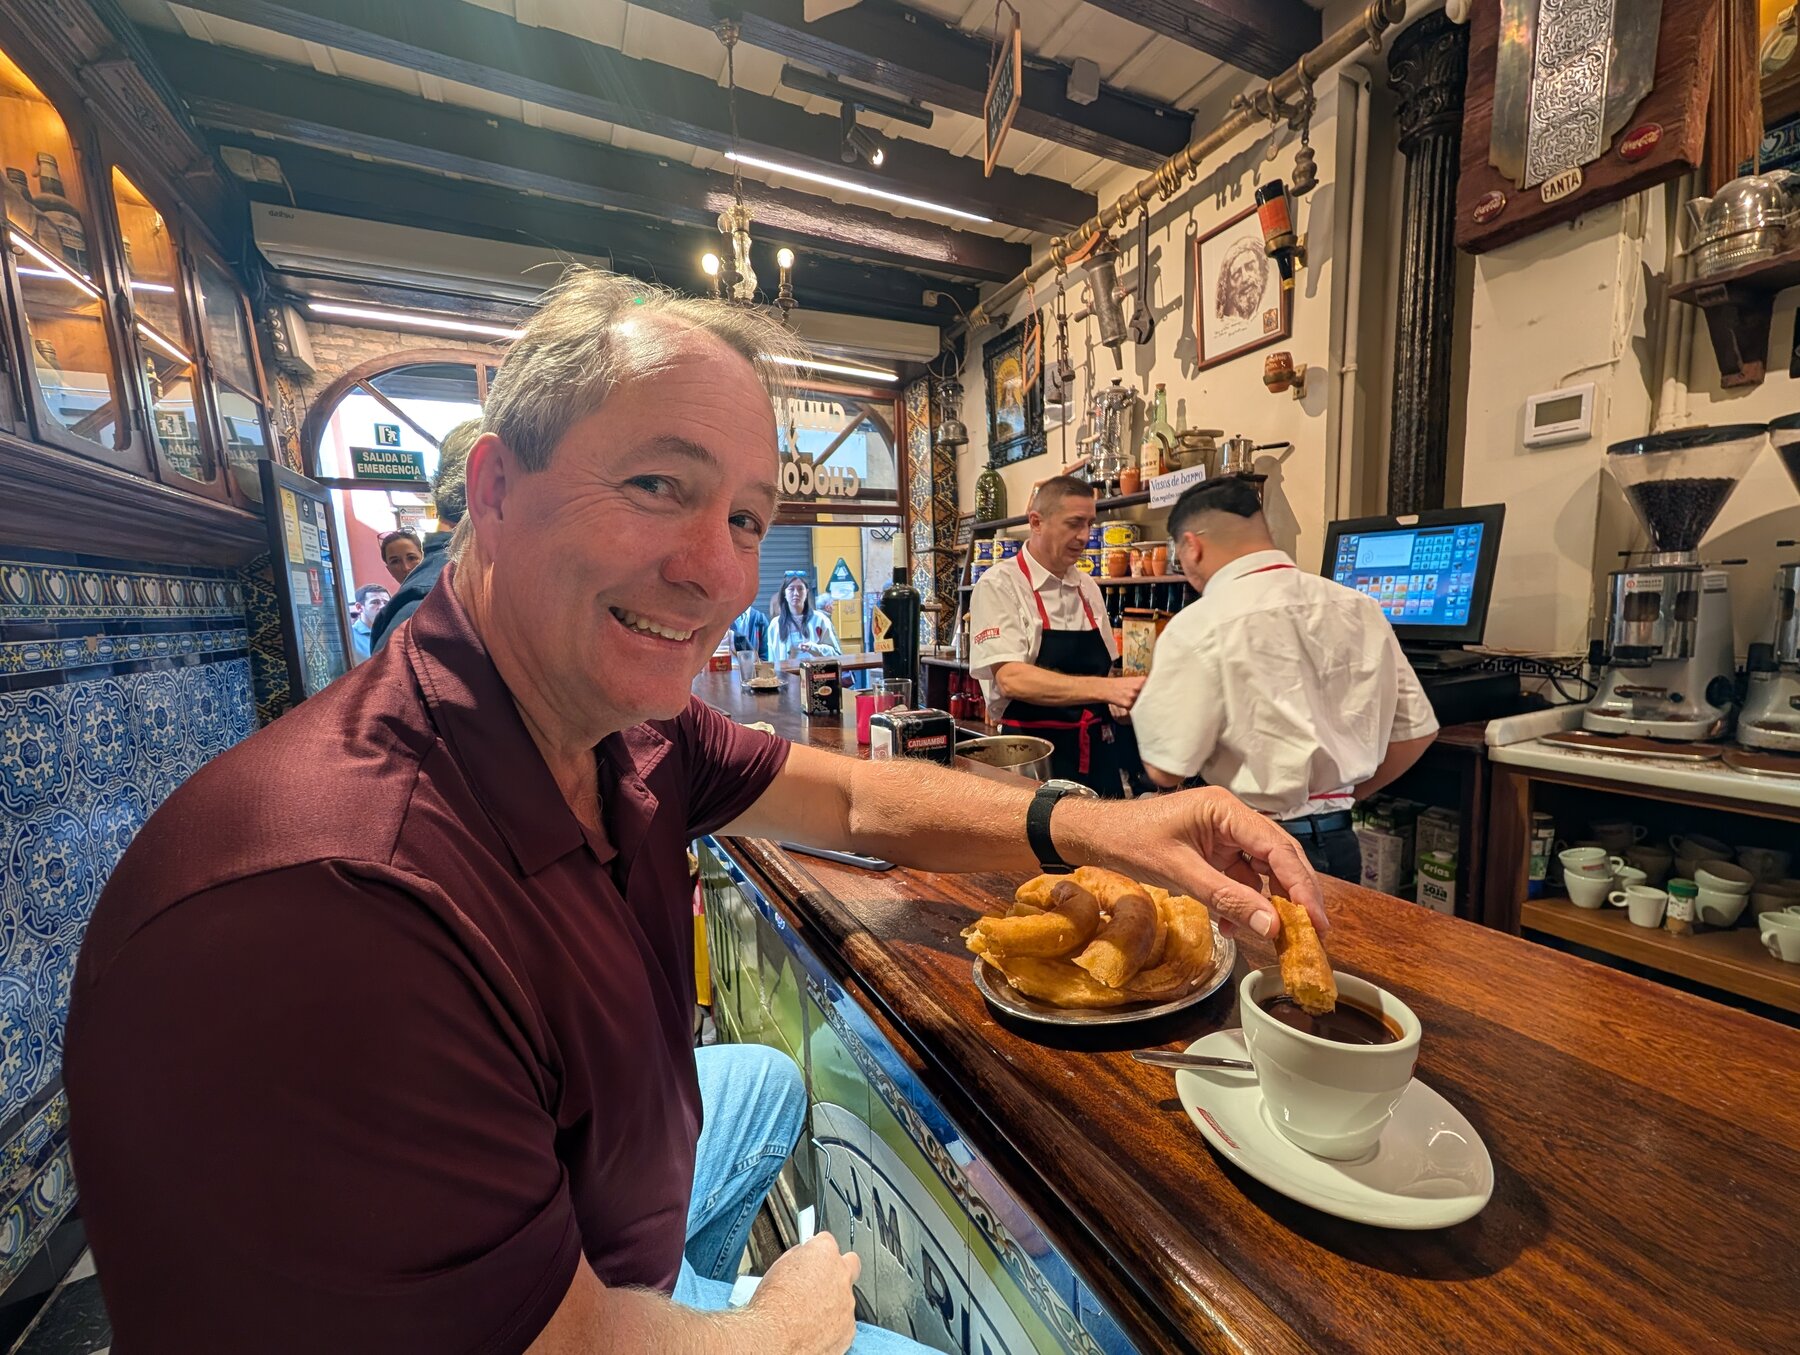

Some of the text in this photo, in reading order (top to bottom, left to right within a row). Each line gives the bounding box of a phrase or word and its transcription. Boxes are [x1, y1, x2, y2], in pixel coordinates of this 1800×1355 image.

[1543, 171, 1580, 199] FANTA
[362, 451, 413, 464] SALIDA DE
[357, 463, 421, 475] EMERGENCIA
[1150, 470, 1204, 492] Vasos de barro
